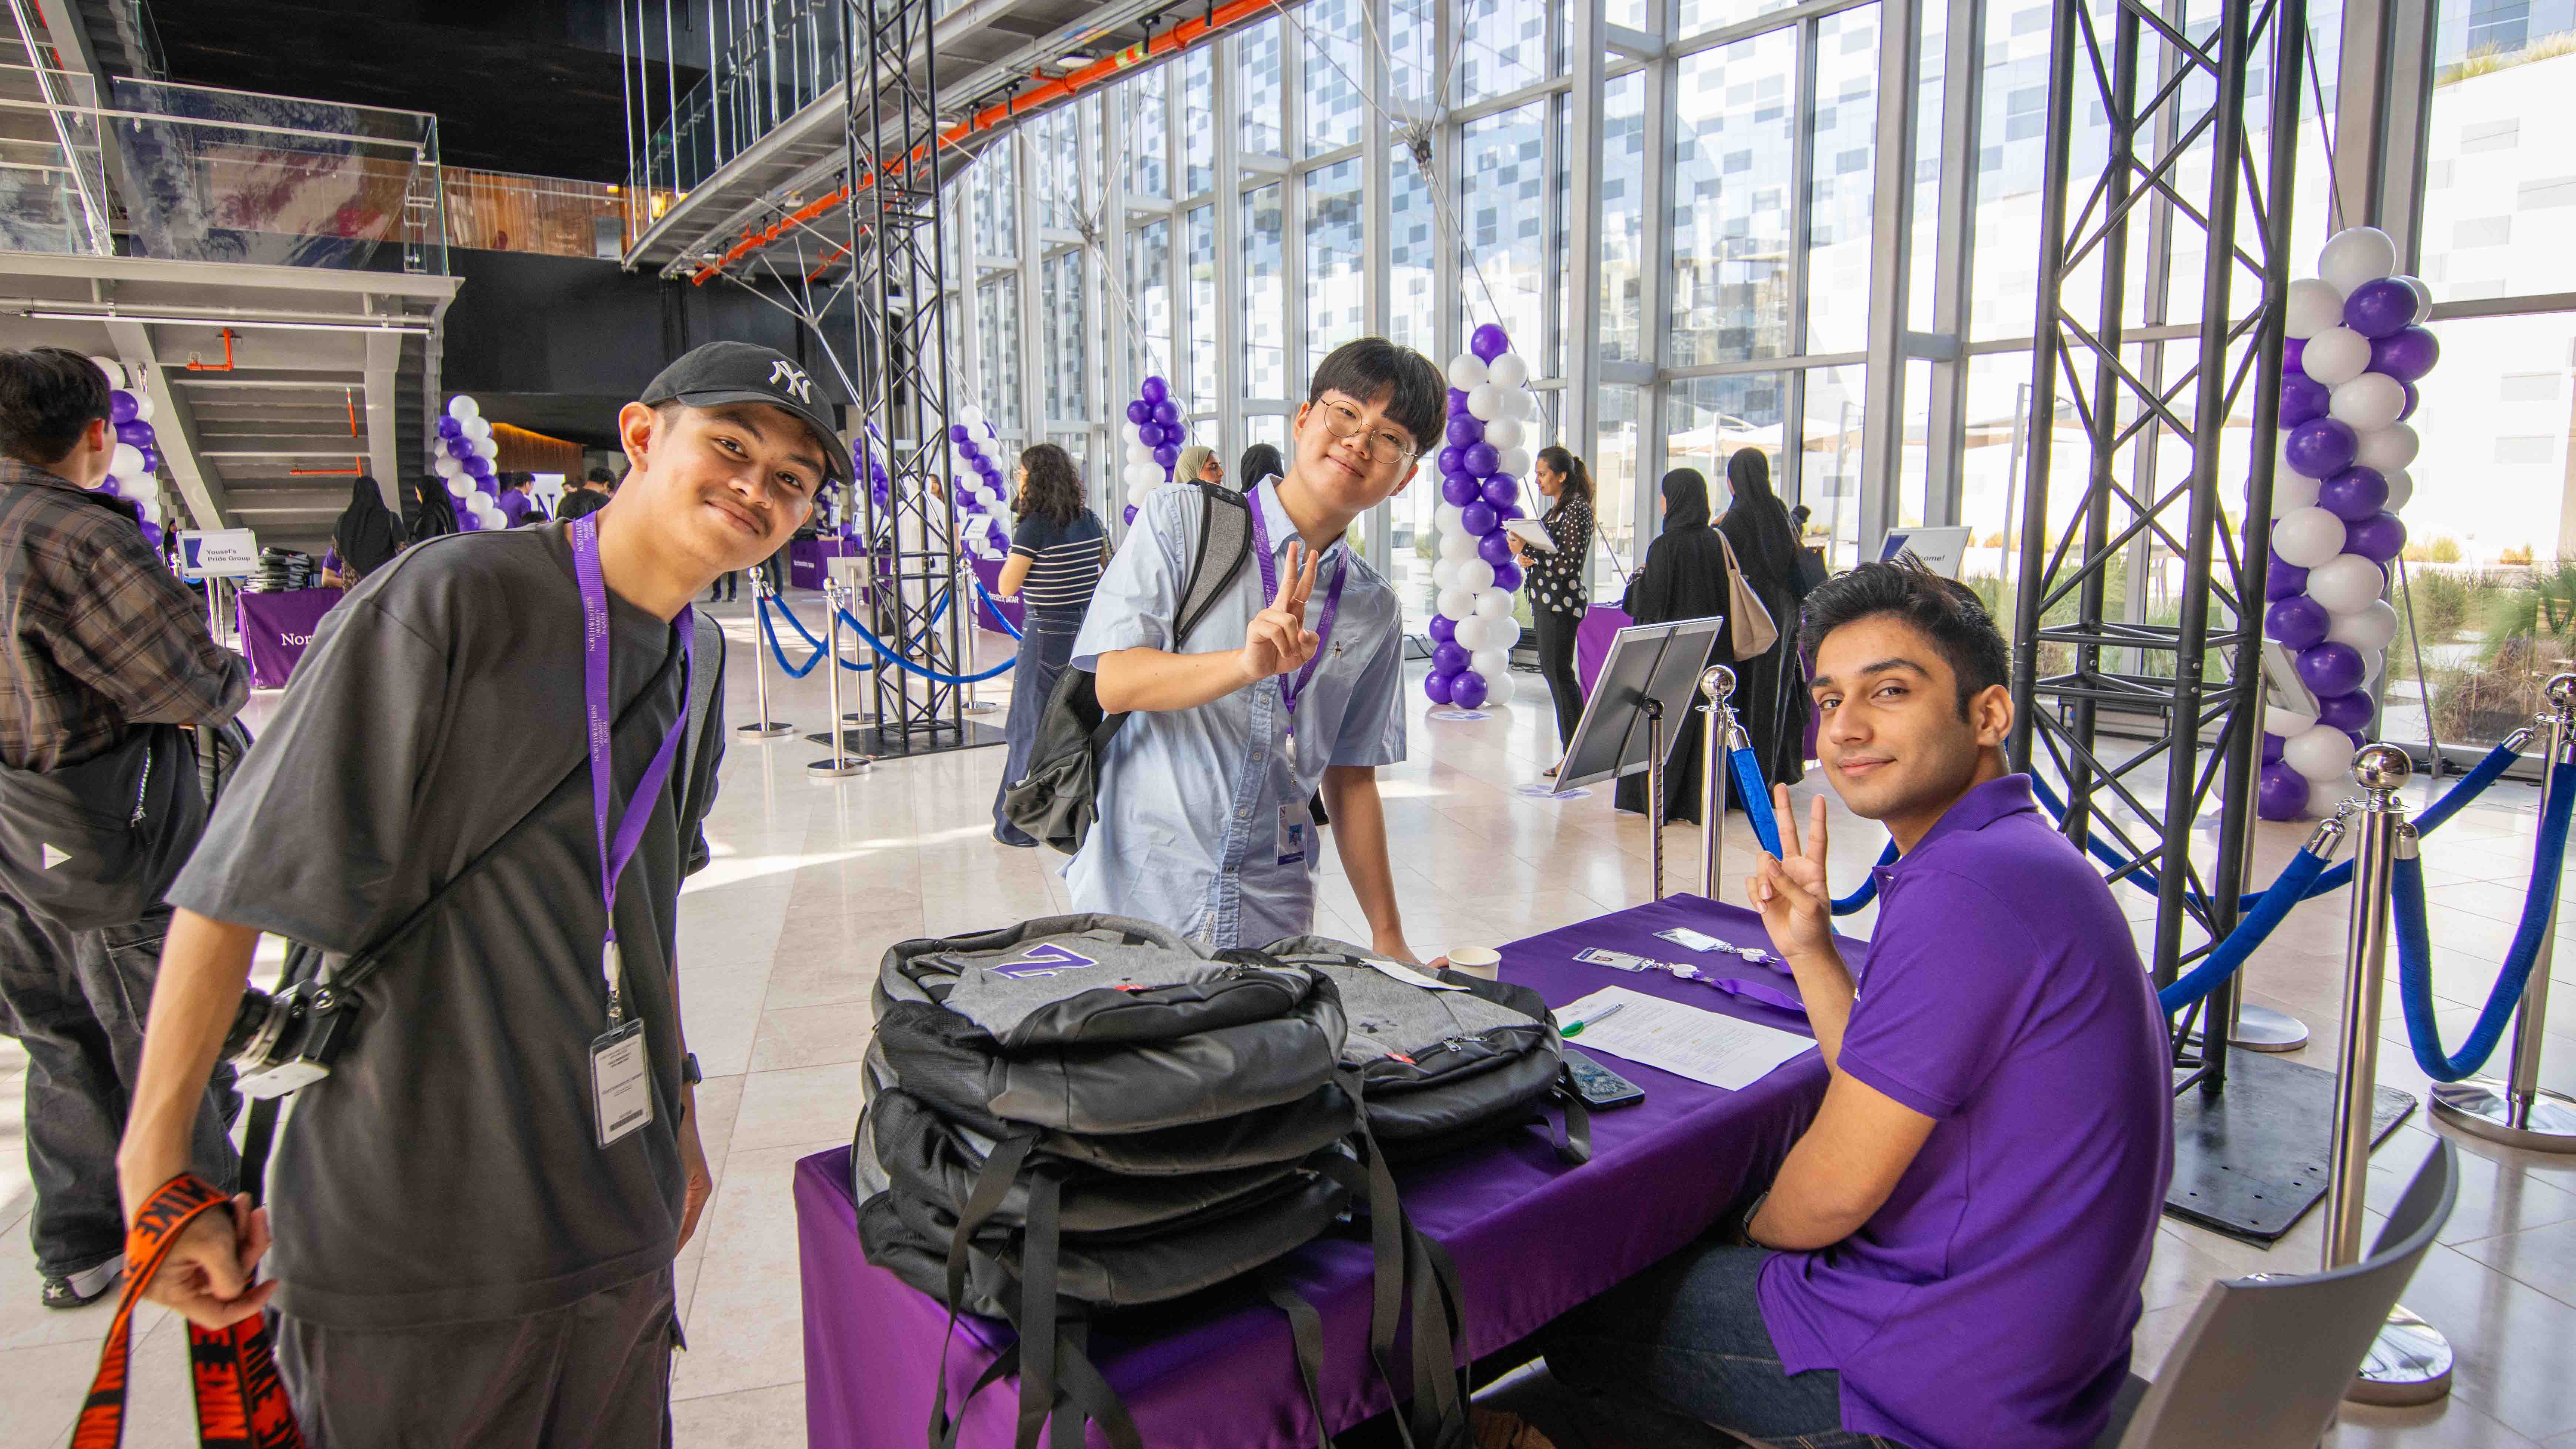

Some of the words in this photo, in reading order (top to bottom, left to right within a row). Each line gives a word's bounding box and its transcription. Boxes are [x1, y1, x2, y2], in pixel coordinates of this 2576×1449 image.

[769, 361, 811, 404] NY
[281, 633, 311, 645] Nor
[586, 596, 596, 651] NORTHWESTERN
[590, 705, 599, 761] NORTHWESTERN
[195, 1361, 248, 1439] NIKE
